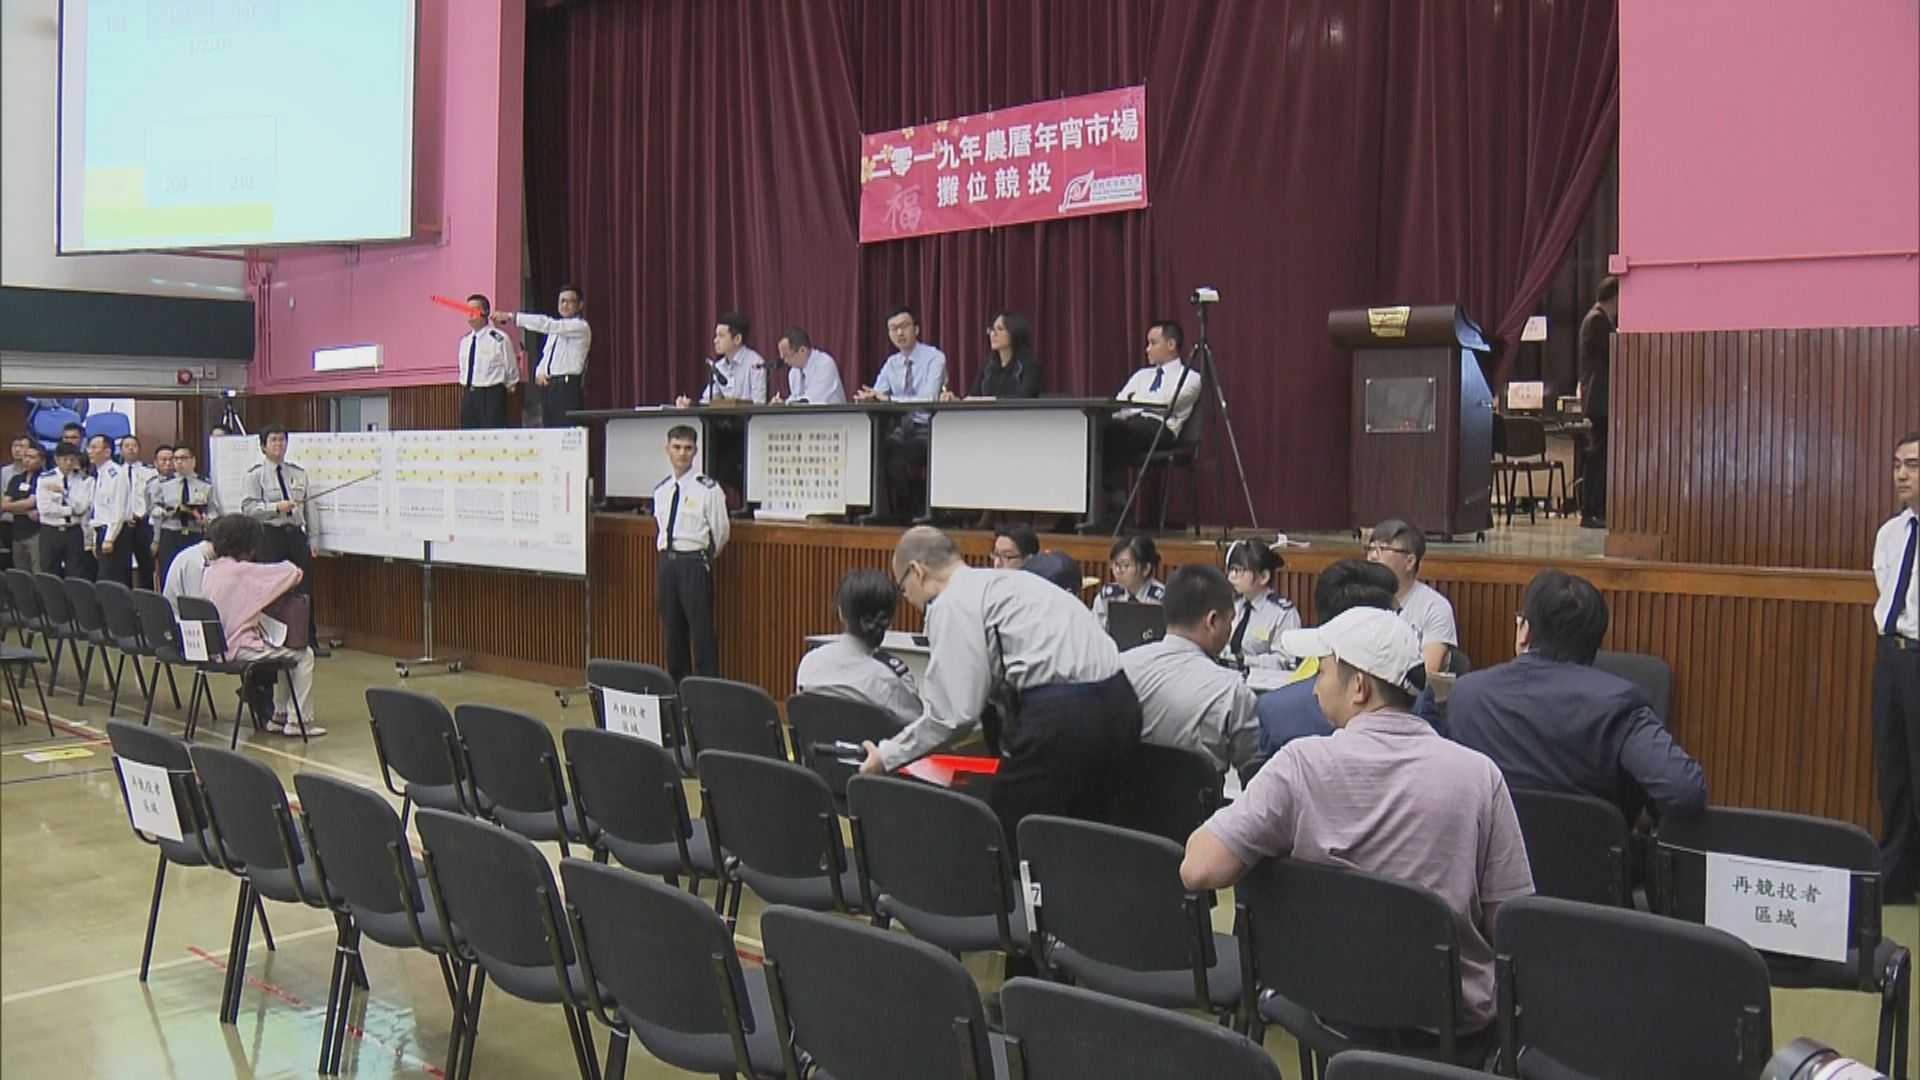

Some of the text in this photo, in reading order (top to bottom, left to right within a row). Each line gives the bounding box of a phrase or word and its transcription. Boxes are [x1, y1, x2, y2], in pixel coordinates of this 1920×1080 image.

[229, 173, 254, 191] 210
[937, 162, 1051, 207] 攤位競投
[1732, 876, 1821, 903] 再競投者
[1755, 906, 1797, 928] 區域
